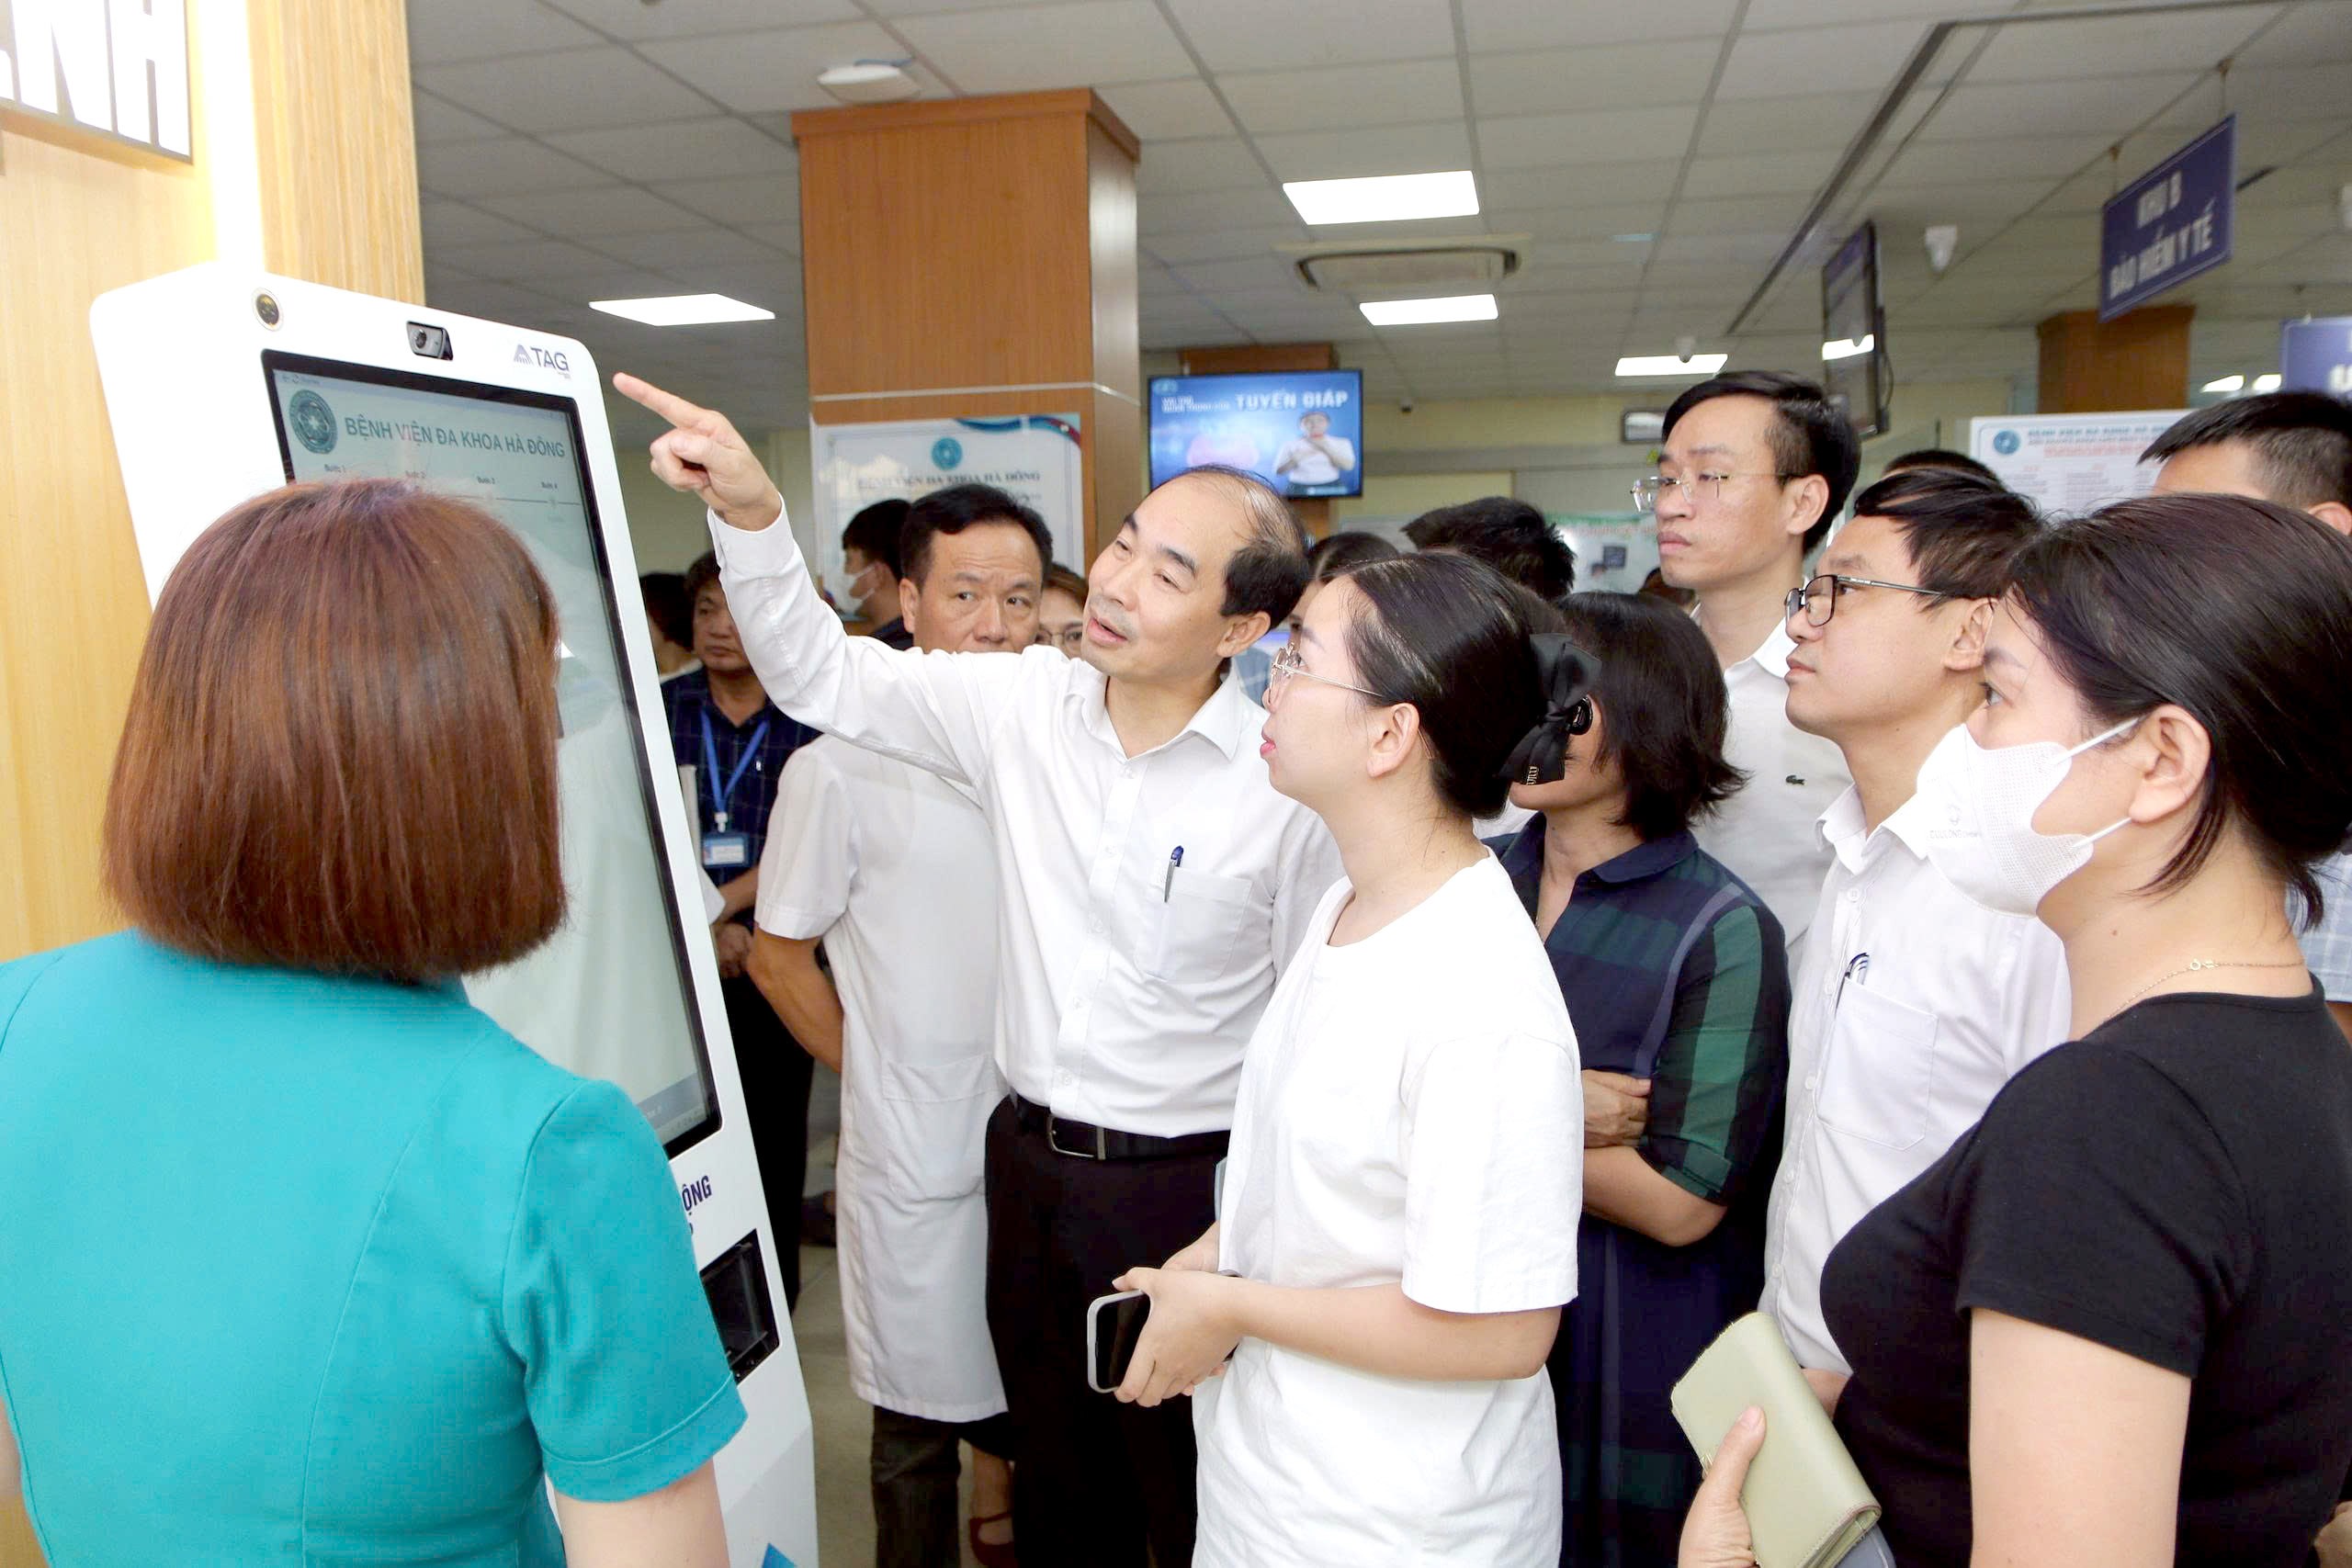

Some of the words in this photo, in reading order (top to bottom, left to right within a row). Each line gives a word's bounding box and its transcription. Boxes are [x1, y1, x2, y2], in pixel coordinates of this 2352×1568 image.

[345, 414, 393, 441] BỆNH
[395, 421, 433, 446] VIỆN
[436, 427, 458, 447] ĐA
[460, 431, 503, 452] KHOA
[505, 434, 526, 454] HÀ
[528, 435, 566, 457] ĐÔNG
